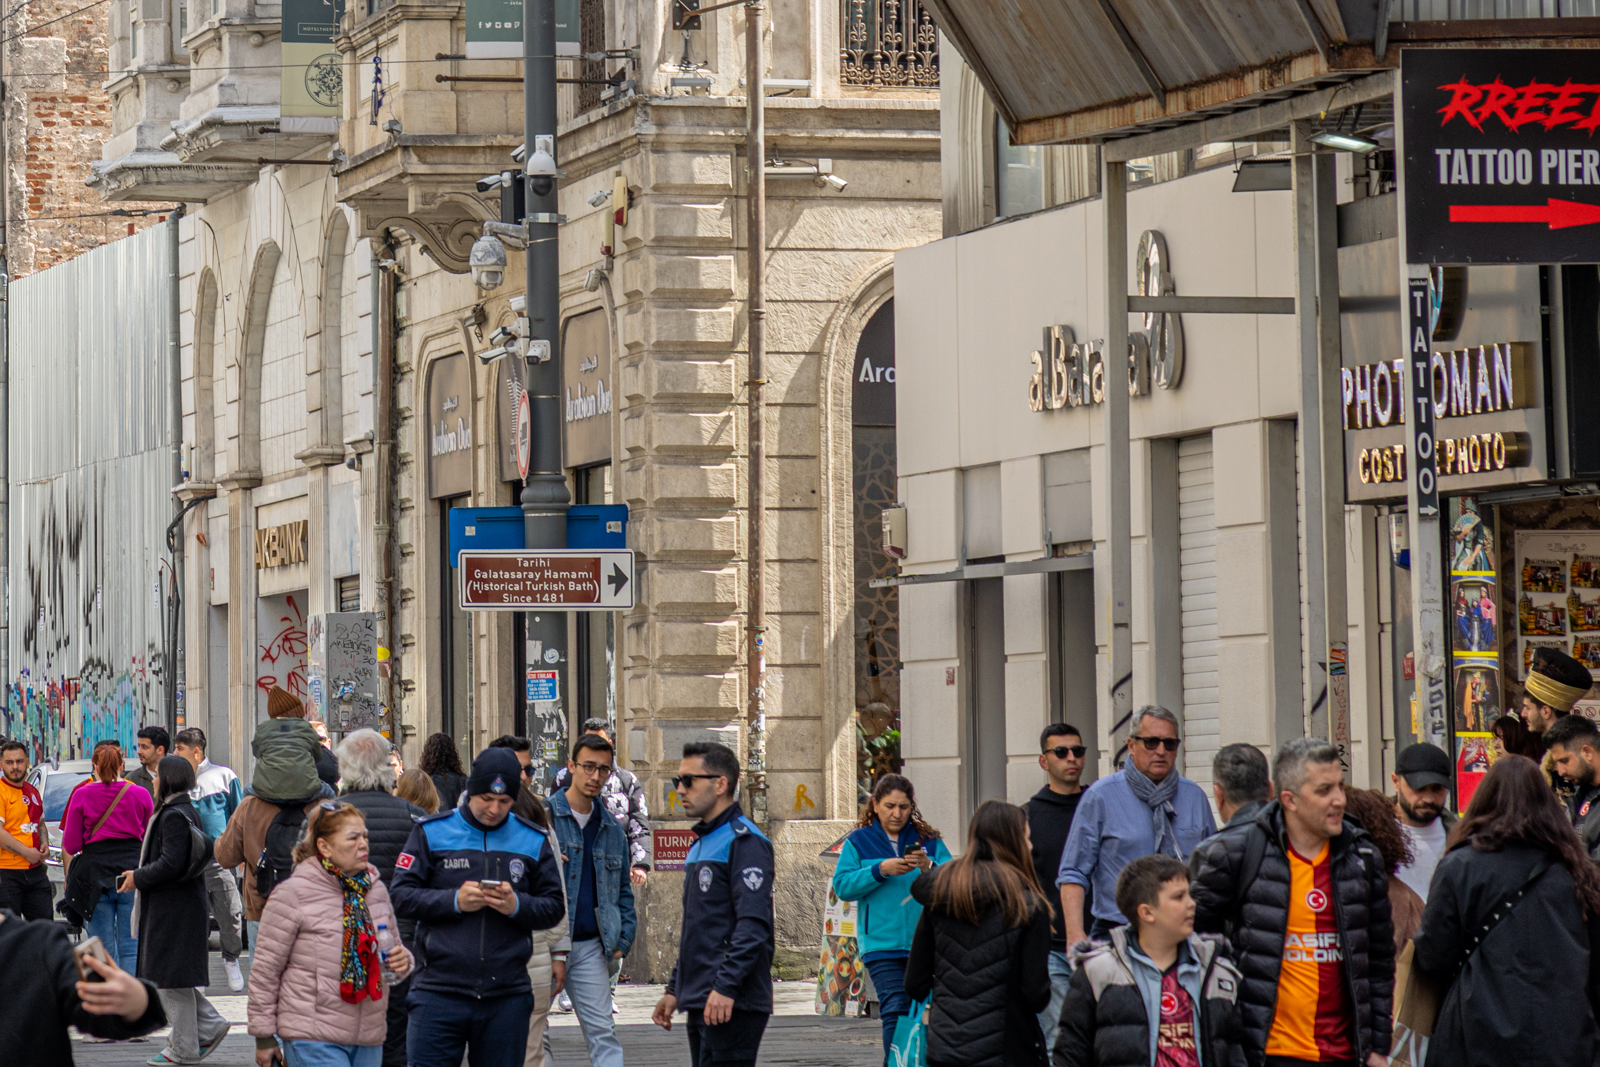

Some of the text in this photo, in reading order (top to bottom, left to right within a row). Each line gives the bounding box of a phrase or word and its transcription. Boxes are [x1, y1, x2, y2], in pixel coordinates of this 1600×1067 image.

[1435, 148, 1533, 185] TATTOO
[1029, 324, 1145, 412] alBaraa
[1341, 342, 1514, 430] PHOTOMAN
[565, 382, 597, 423] Arabian
[1413, 291, 1434, 495] TATTOO
[1446, 432, 1506, 475] PHOTO
[254, 521, 307, 570] AKBANK
[517, 558, 550, 567] Tarihi
[474, 569, 593, 581] Galatasaray Hamamı
[526, 581, 565, 591] Turkish
[503, 594, 564, 603] Since 1481
[444, 858, 470, 869] ZABITA
